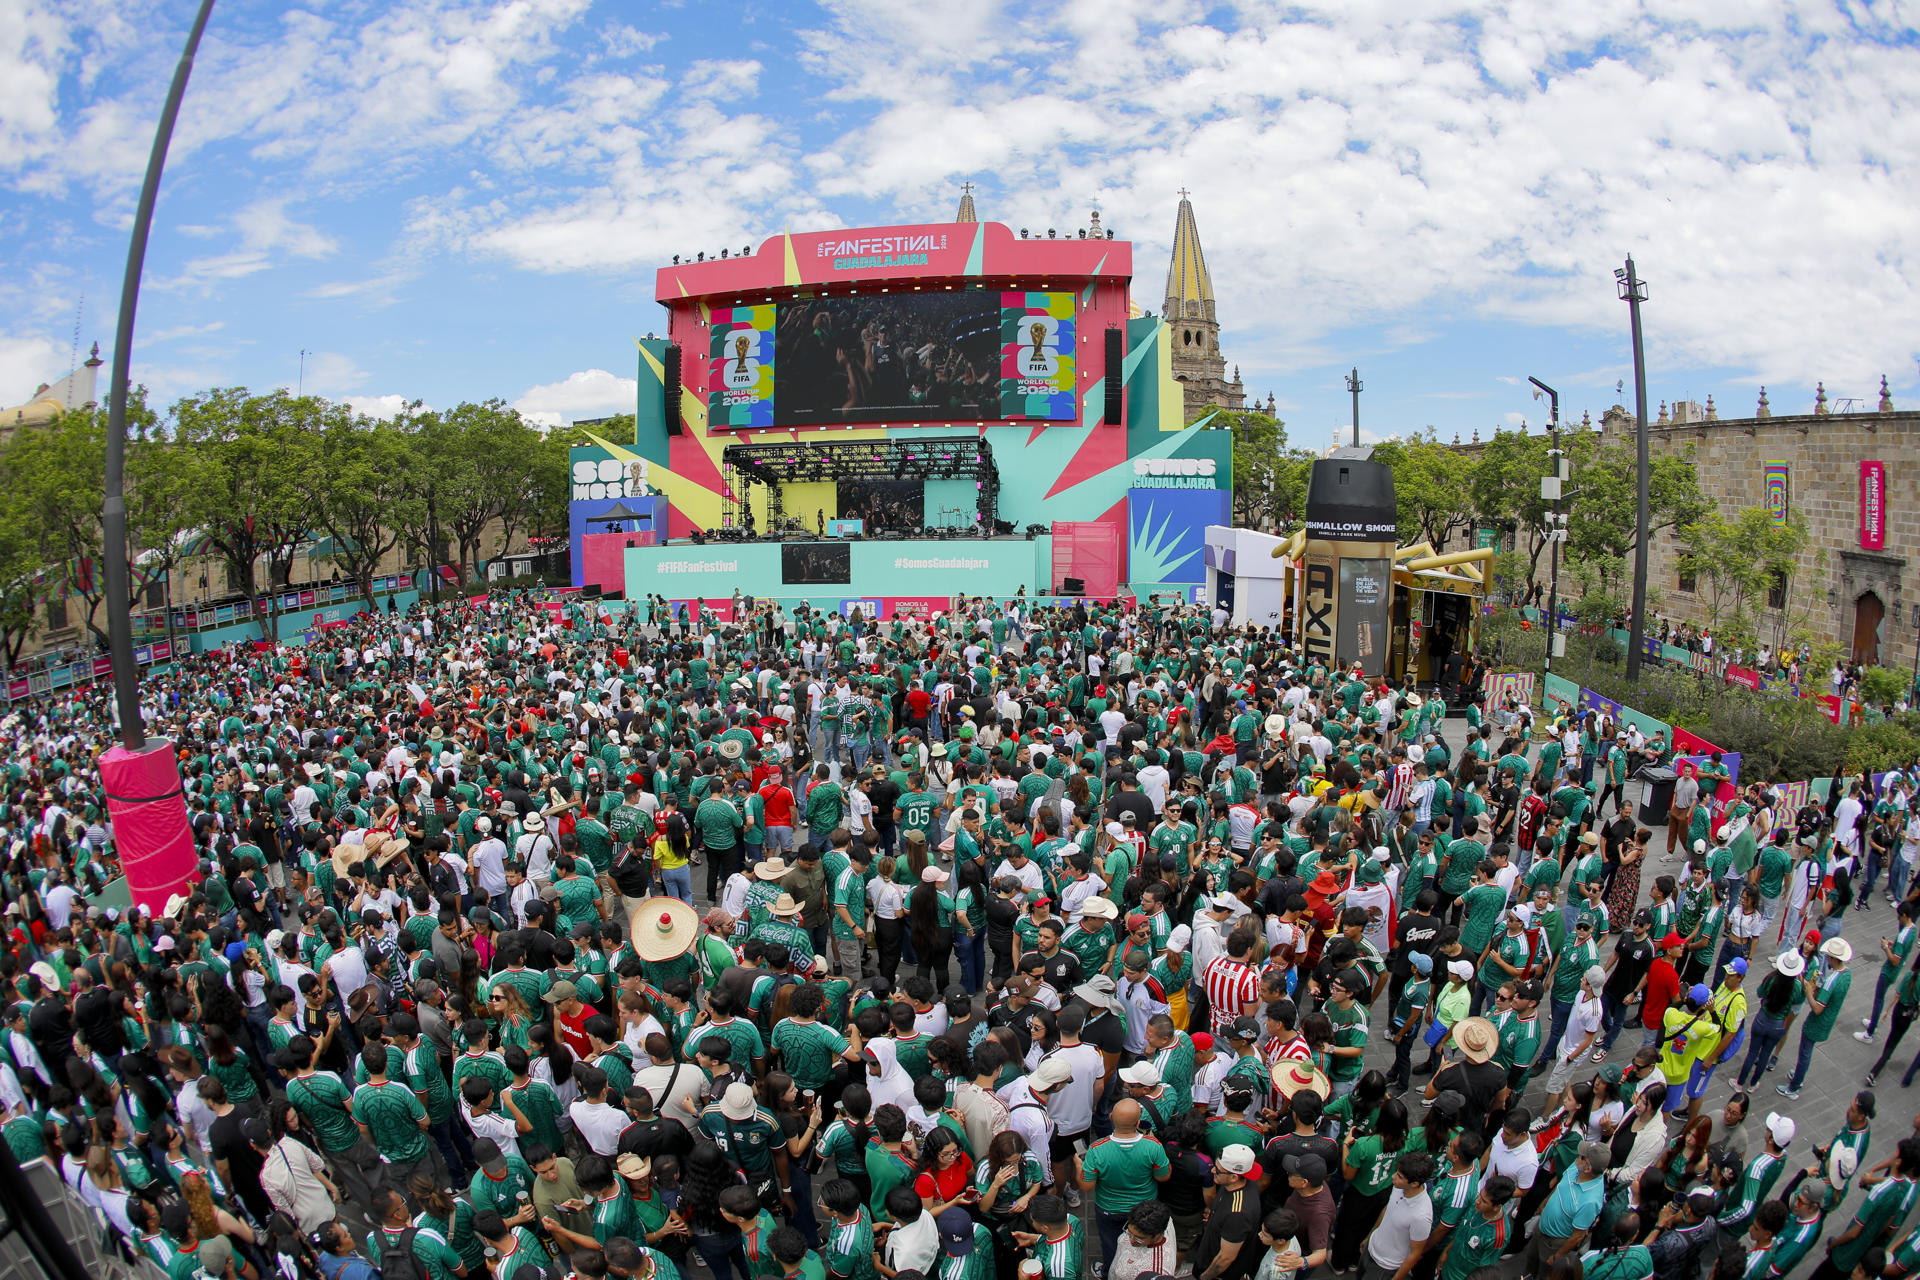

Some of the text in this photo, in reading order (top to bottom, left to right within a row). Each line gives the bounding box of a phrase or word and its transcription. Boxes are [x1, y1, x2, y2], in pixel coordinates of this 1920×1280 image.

[833, 253, 929, 271] GUADALAJARA
[1029, 364, 1048, 372] FIFA
[733, 375, 750, 383] FIFA
[722, 389, 746, 397] WORLD
[1017, 385, 1060, 395] 2026
[722, 395, 760, 406] 2026
[1134, 458, 1217, 476] SOMOS
[1133, 476, 1217, 490] GUADALAJARA
[1365, 524, 1396, 532] SMOKE
[657, 560, 738, 574] #FIFAFanFestival
[894, 557, 990, 570] #SomosGuadalajara
[908, 807, 930, 825] 05
